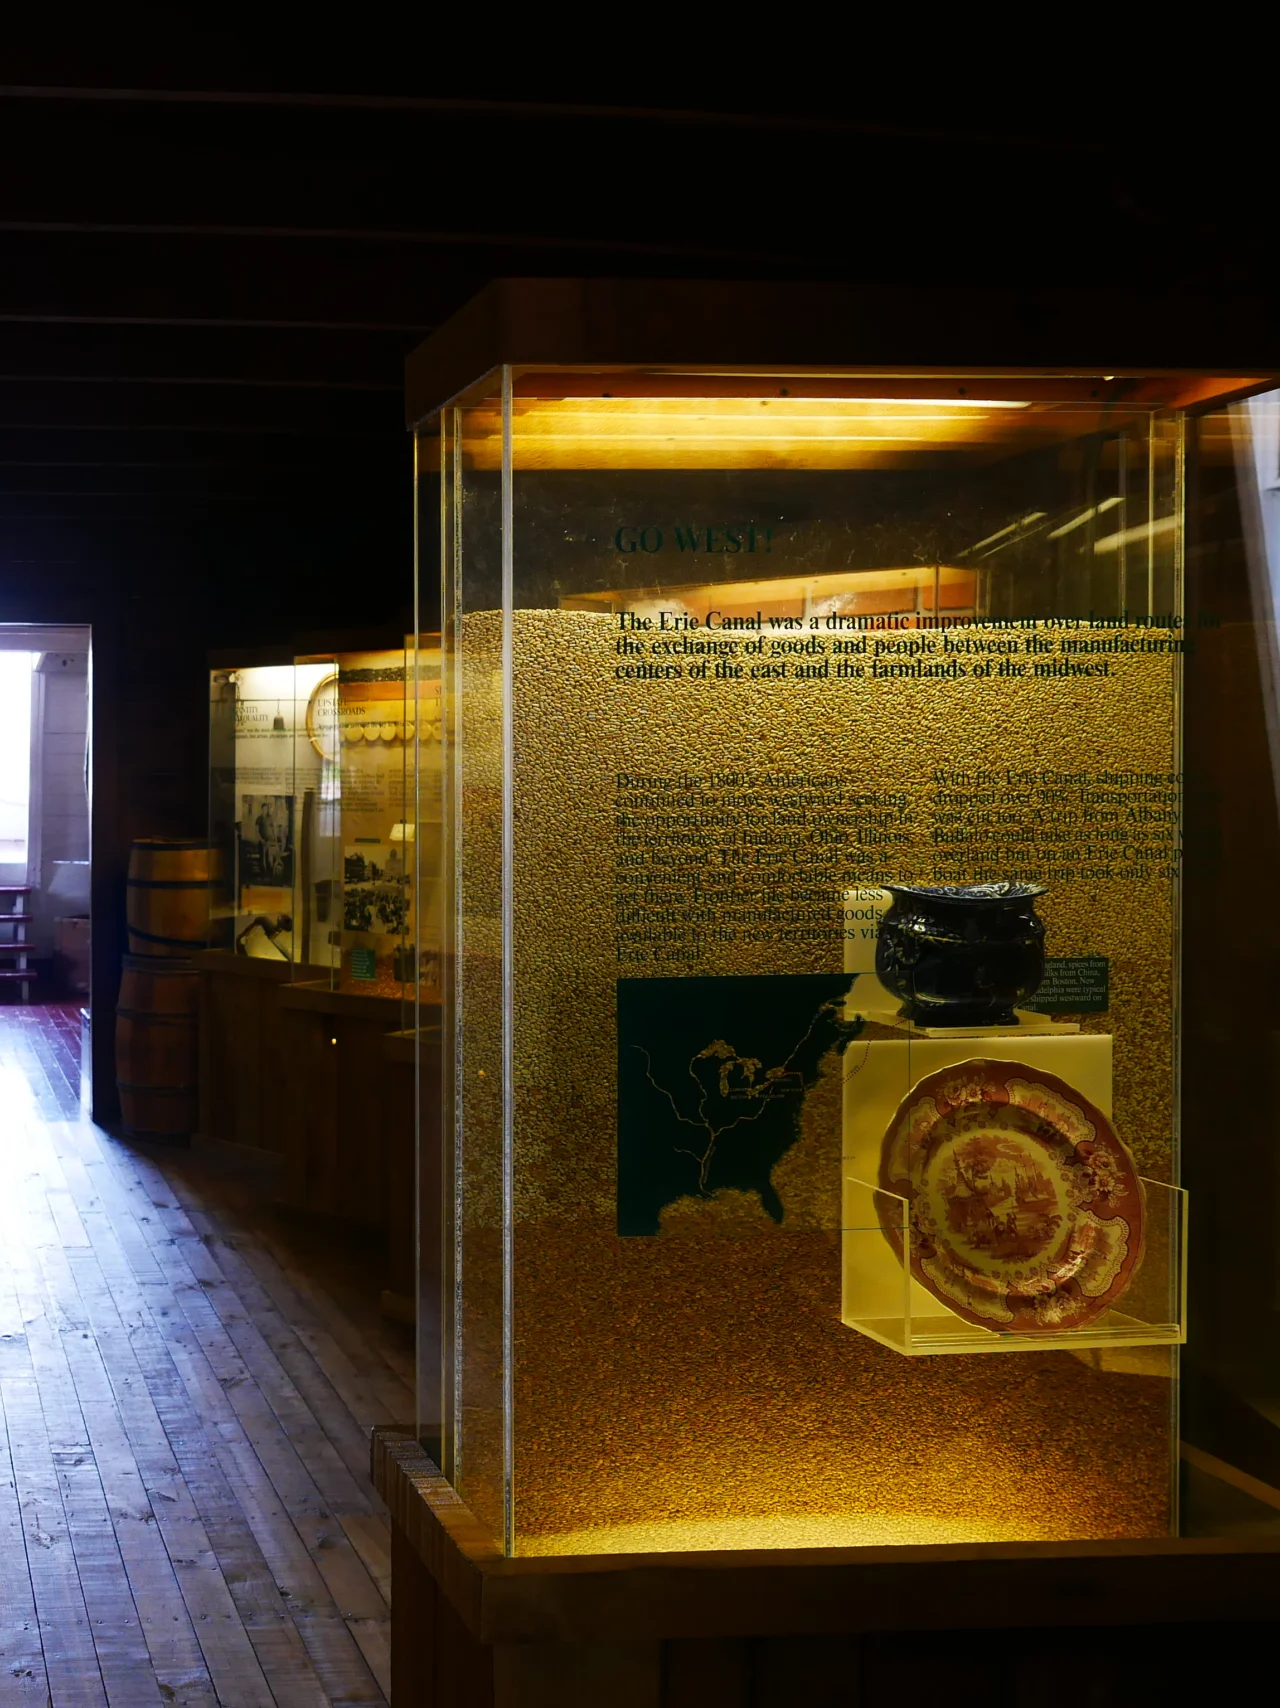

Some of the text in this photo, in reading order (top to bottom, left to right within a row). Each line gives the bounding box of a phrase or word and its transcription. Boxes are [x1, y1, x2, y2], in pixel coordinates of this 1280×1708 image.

[615, 527, 773, 553] GO WEST!
[616, 611, 1128, 632] The Erie Canal was a dramatic improvement over land
[616, 634, 1054, 659] the exchange of goods and people between the
[616, 659, 1116, 680] centers of the east and the farmlands of the midwest.
[318, 707, 365, 716] CROSSROADS
[855, 886, 883, 901] less
[860, 924, 880, 940] via
